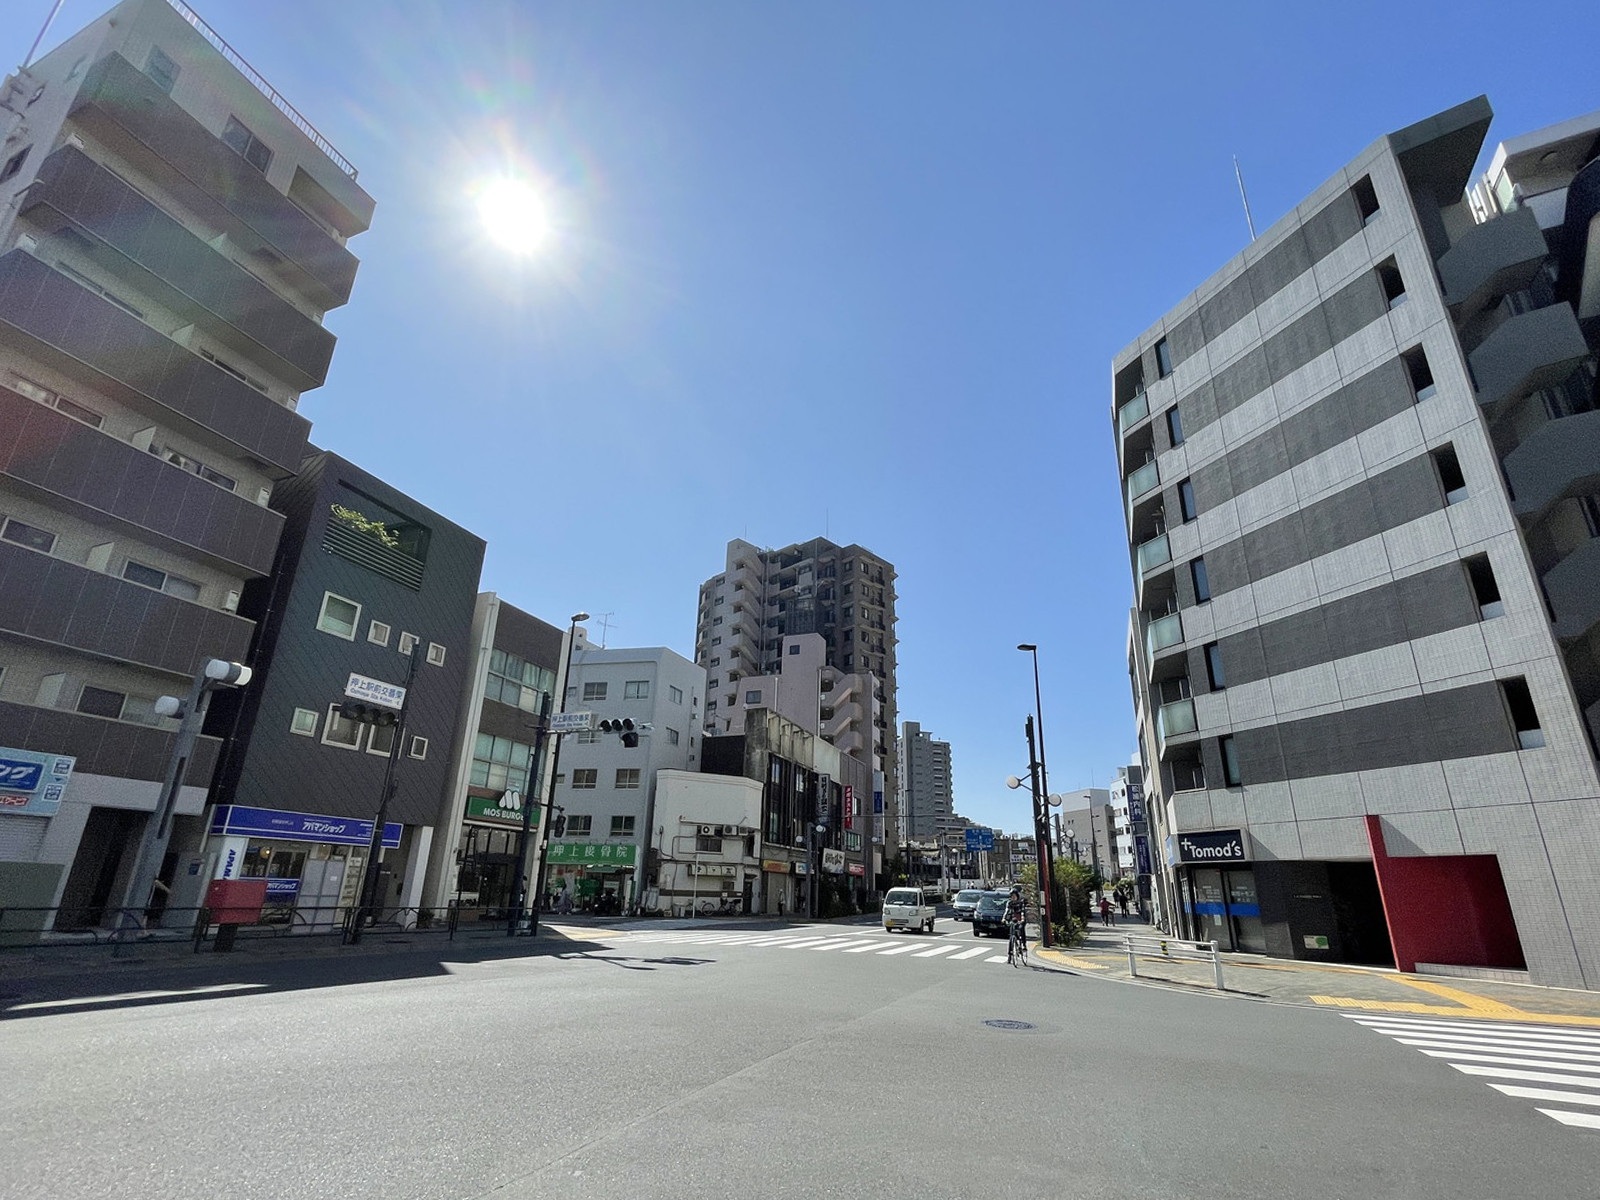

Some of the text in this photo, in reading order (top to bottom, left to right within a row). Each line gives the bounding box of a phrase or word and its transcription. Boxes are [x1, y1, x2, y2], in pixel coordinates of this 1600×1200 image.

[483, 807, 524, 821] MOS BURGE
[302, 821, 347, 834] アパマンショップ
[554, 845, 629, 858] 押上接骨院
[1189, 840, 1242, 858] Tomod's
[223, 848, 237, 880] APAM
